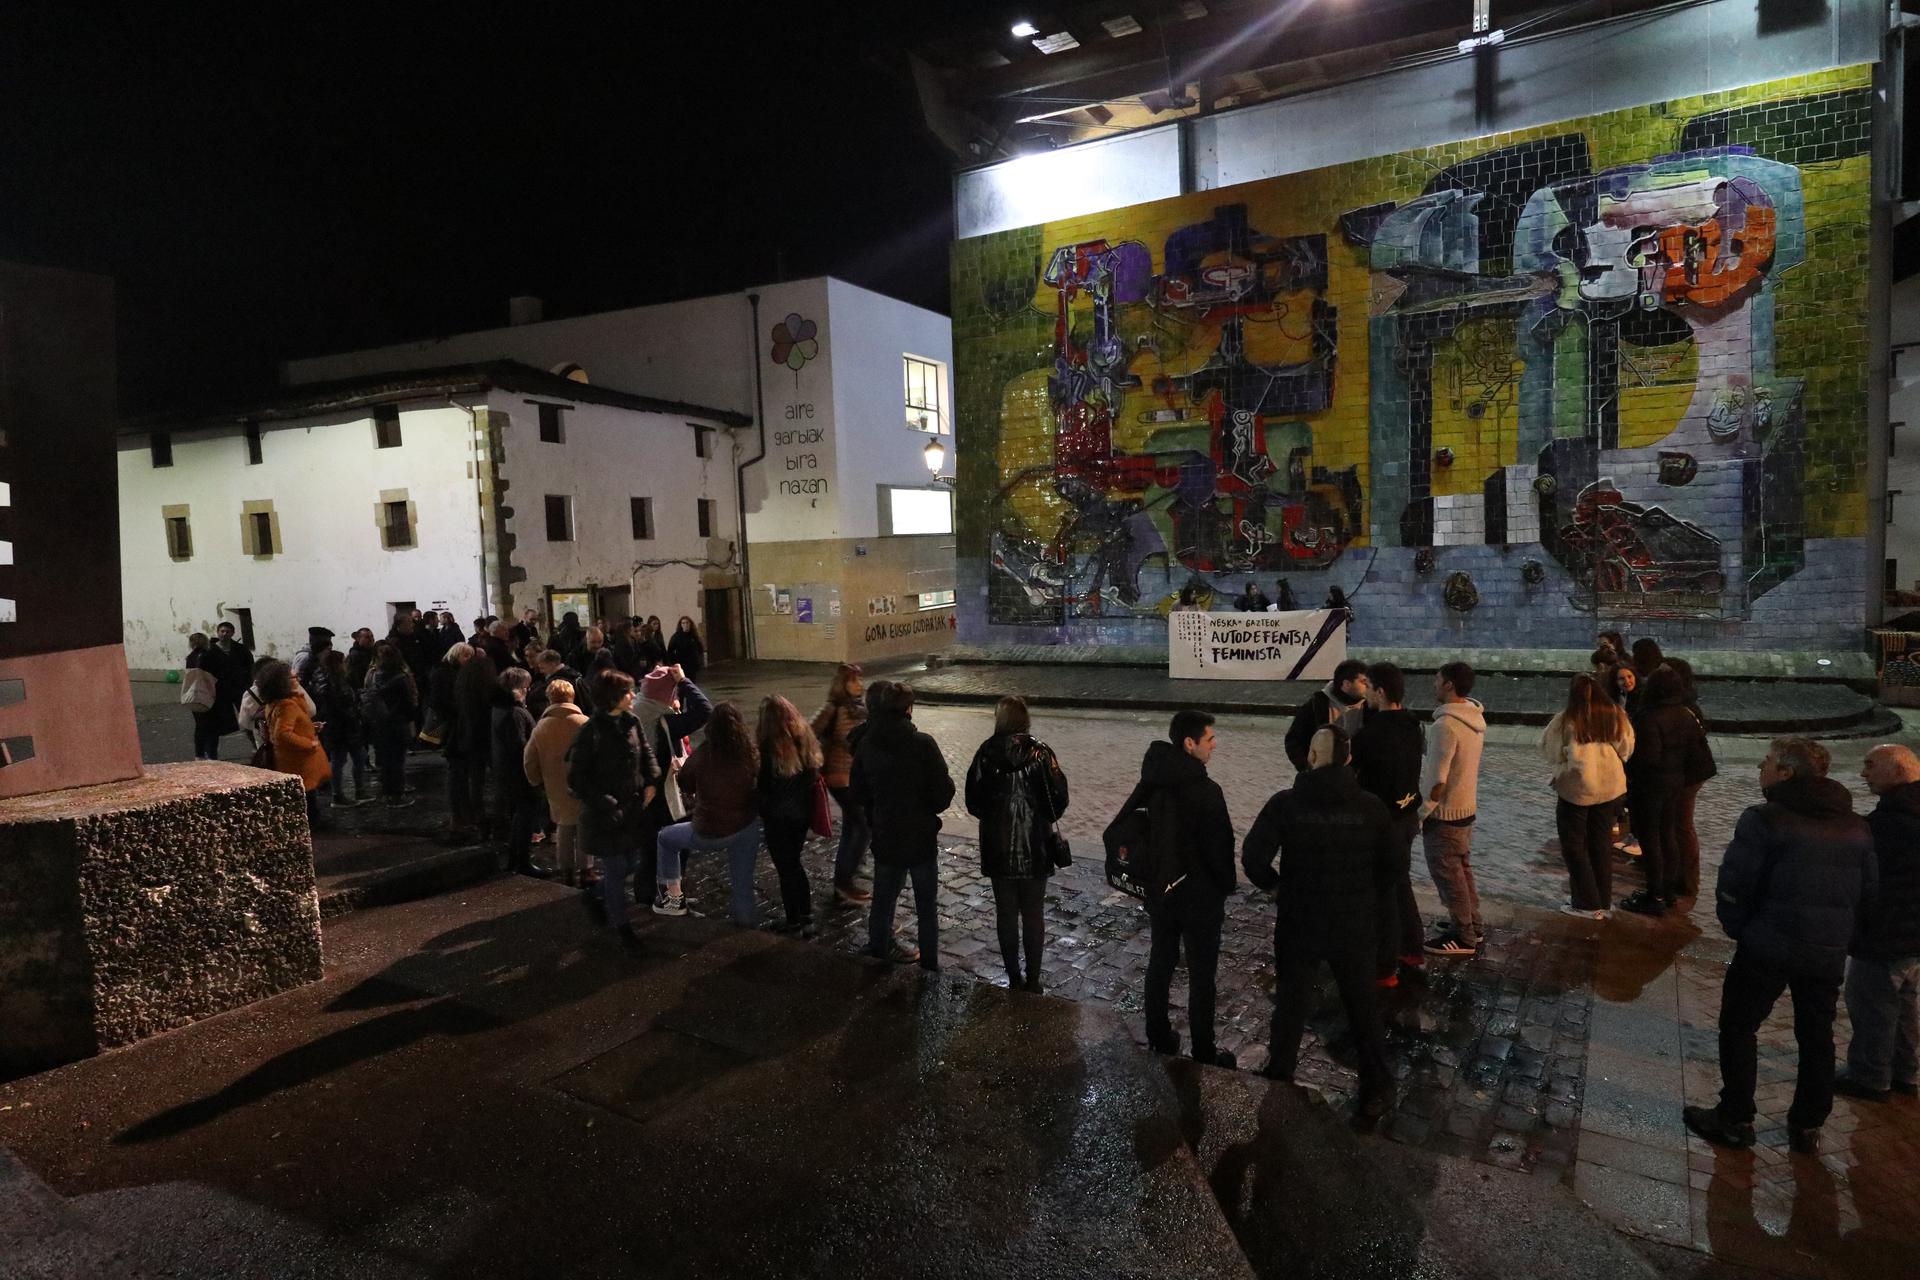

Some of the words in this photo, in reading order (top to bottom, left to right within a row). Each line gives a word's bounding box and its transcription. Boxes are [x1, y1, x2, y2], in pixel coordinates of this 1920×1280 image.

[785, 403, 814, 420] aire
[774, 428, 824, 446] garbiak
[786, 453, 817, 470] bira
[780, 478, 828, 495] nazan
[865, 624, 887, 642] GORA
[889, 623, 911, 638] EUSKO
[913, 615, 947, 634] GUDARIAK
[1245, 618, 1280, 627] GAZTEOK
[1211, 630, 1311, 646] AUTODEFENTSA
[1212, 647, 1282, 663] FEMINISTA
